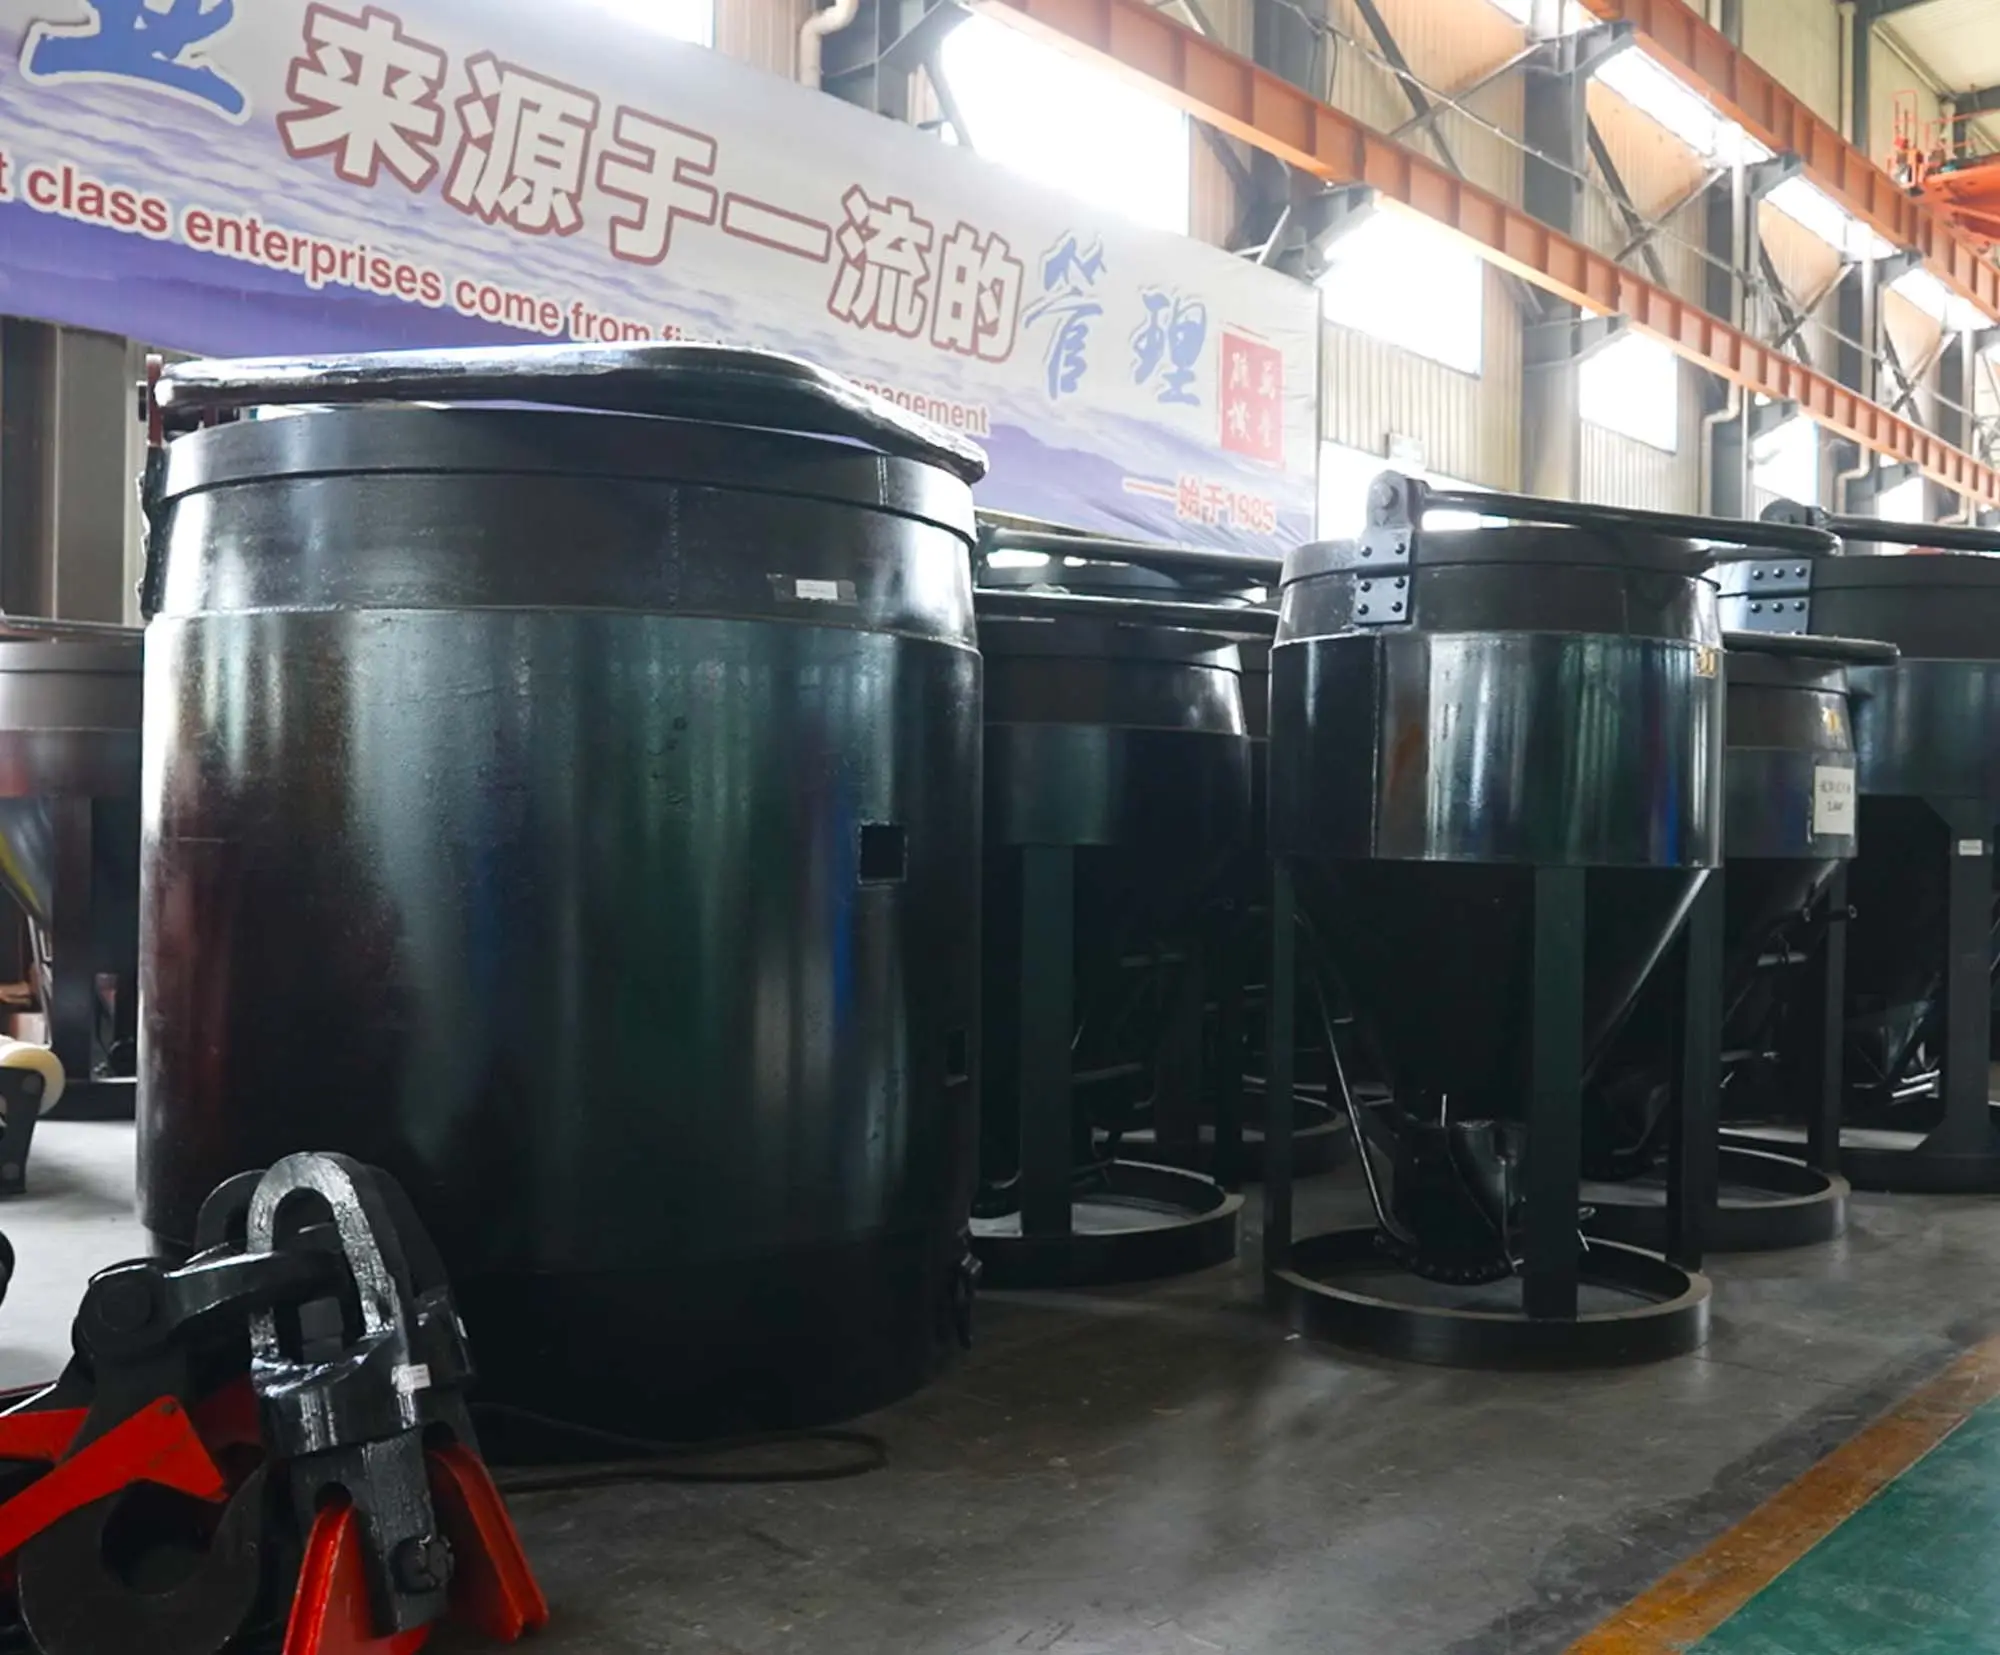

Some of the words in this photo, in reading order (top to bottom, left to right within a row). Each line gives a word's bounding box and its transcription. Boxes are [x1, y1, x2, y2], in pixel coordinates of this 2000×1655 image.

[27, 164, 169, 235] class
[185, 208, 442, 302] enterprises
[455, 279, 561, 331] come
[571, 301, 650, 343] from
